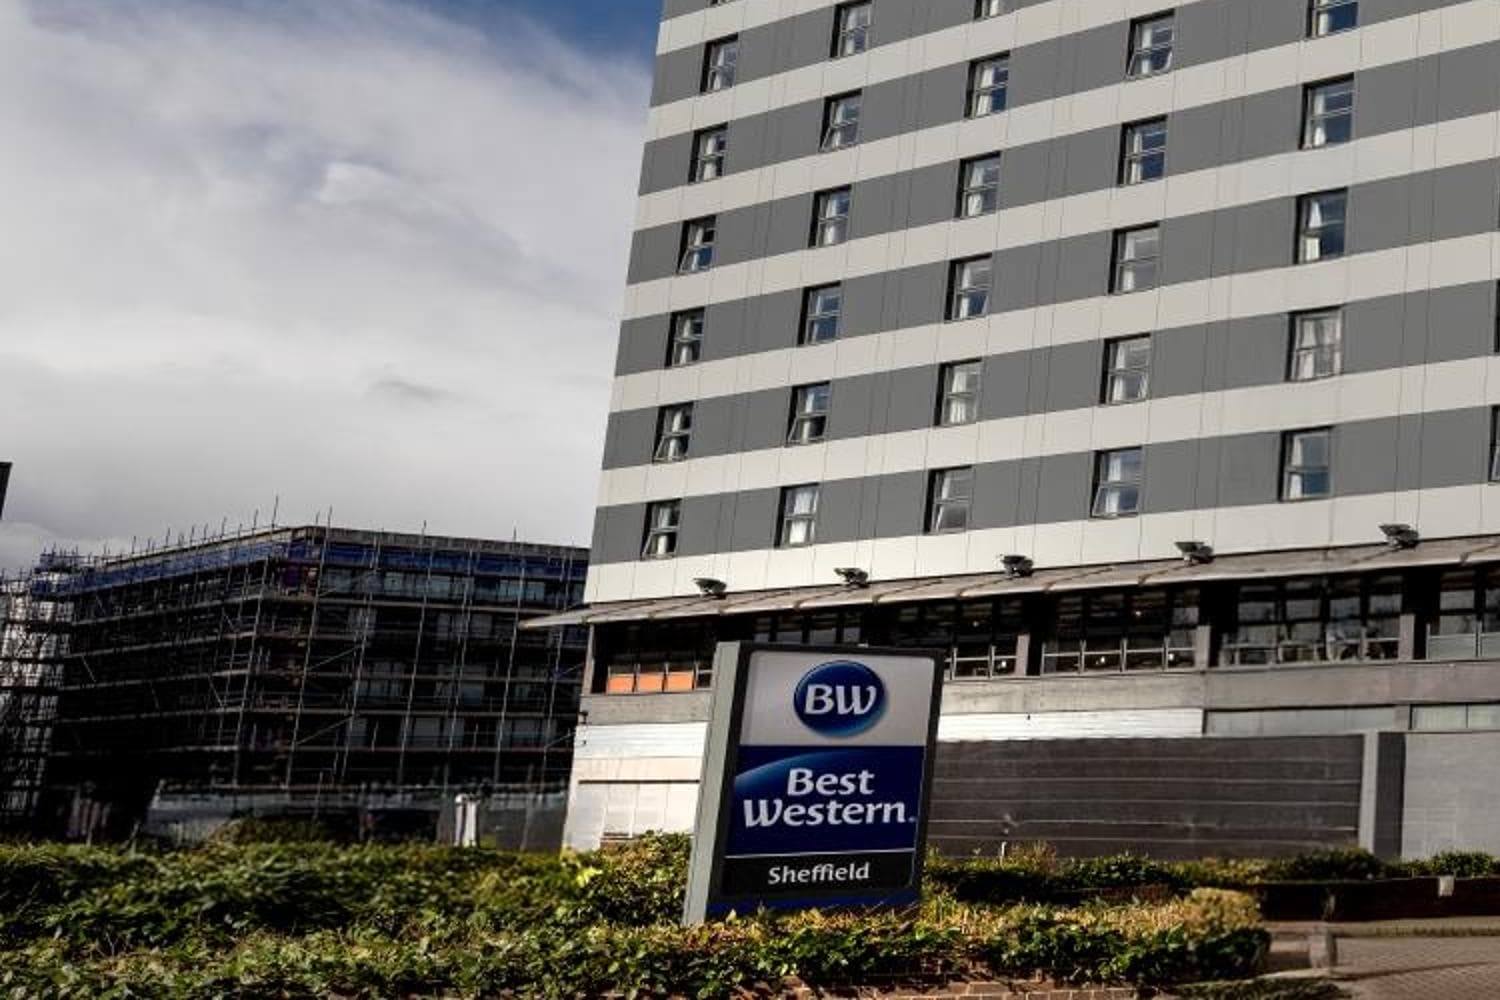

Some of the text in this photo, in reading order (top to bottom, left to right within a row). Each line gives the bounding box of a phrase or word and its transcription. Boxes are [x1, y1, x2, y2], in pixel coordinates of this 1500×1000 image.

[804, 684, 876, 715] BW
[787, 767, 874, 796] Best
[743, 798, 906, 828] Western
[768, 862, 870, 884] Sheffield
